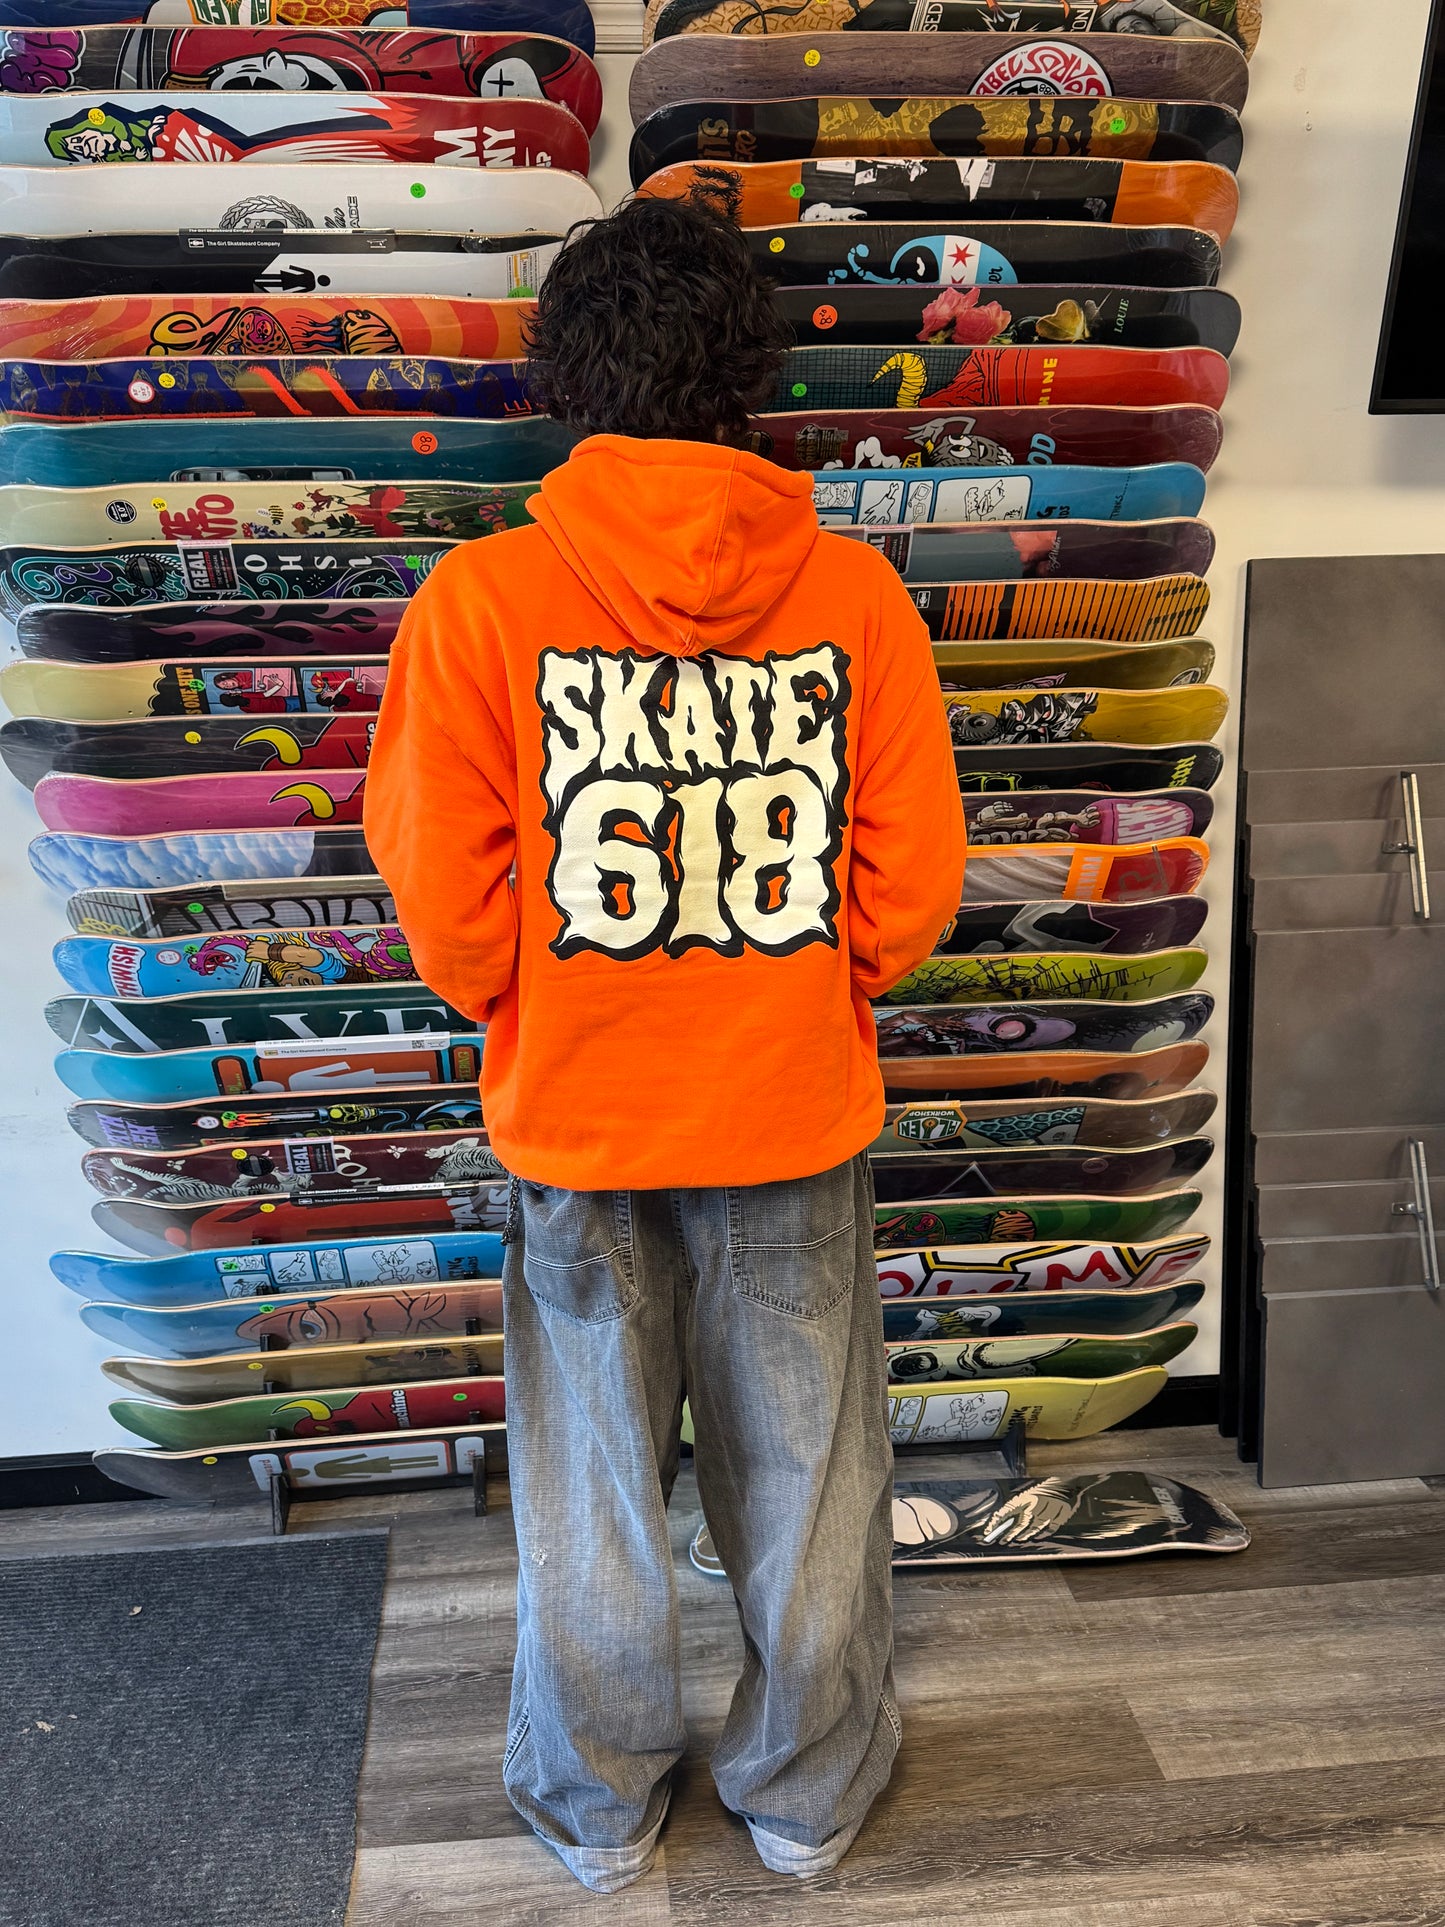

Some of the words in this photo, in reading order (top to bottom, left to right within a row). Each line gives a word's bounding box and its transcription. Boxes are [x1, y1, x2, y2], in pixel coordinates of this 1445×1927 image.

[256, 240, 281, 248] Company
[1113, 299, 1130, 334] LOUIE
[187, 551, 211, 588] REAL
[180, 688, 201, 708] ONE
[537, 642, 851, 806] SKATE
[547, 766, 843, 960] 618
[899, 1117, 962, 1140] ALIEN
[908, 1110, 955, 1118] WORKSHOP
[292, 1145, 312, 1173] REAL
[1151, 1485, 1187, 1524] BAKER
